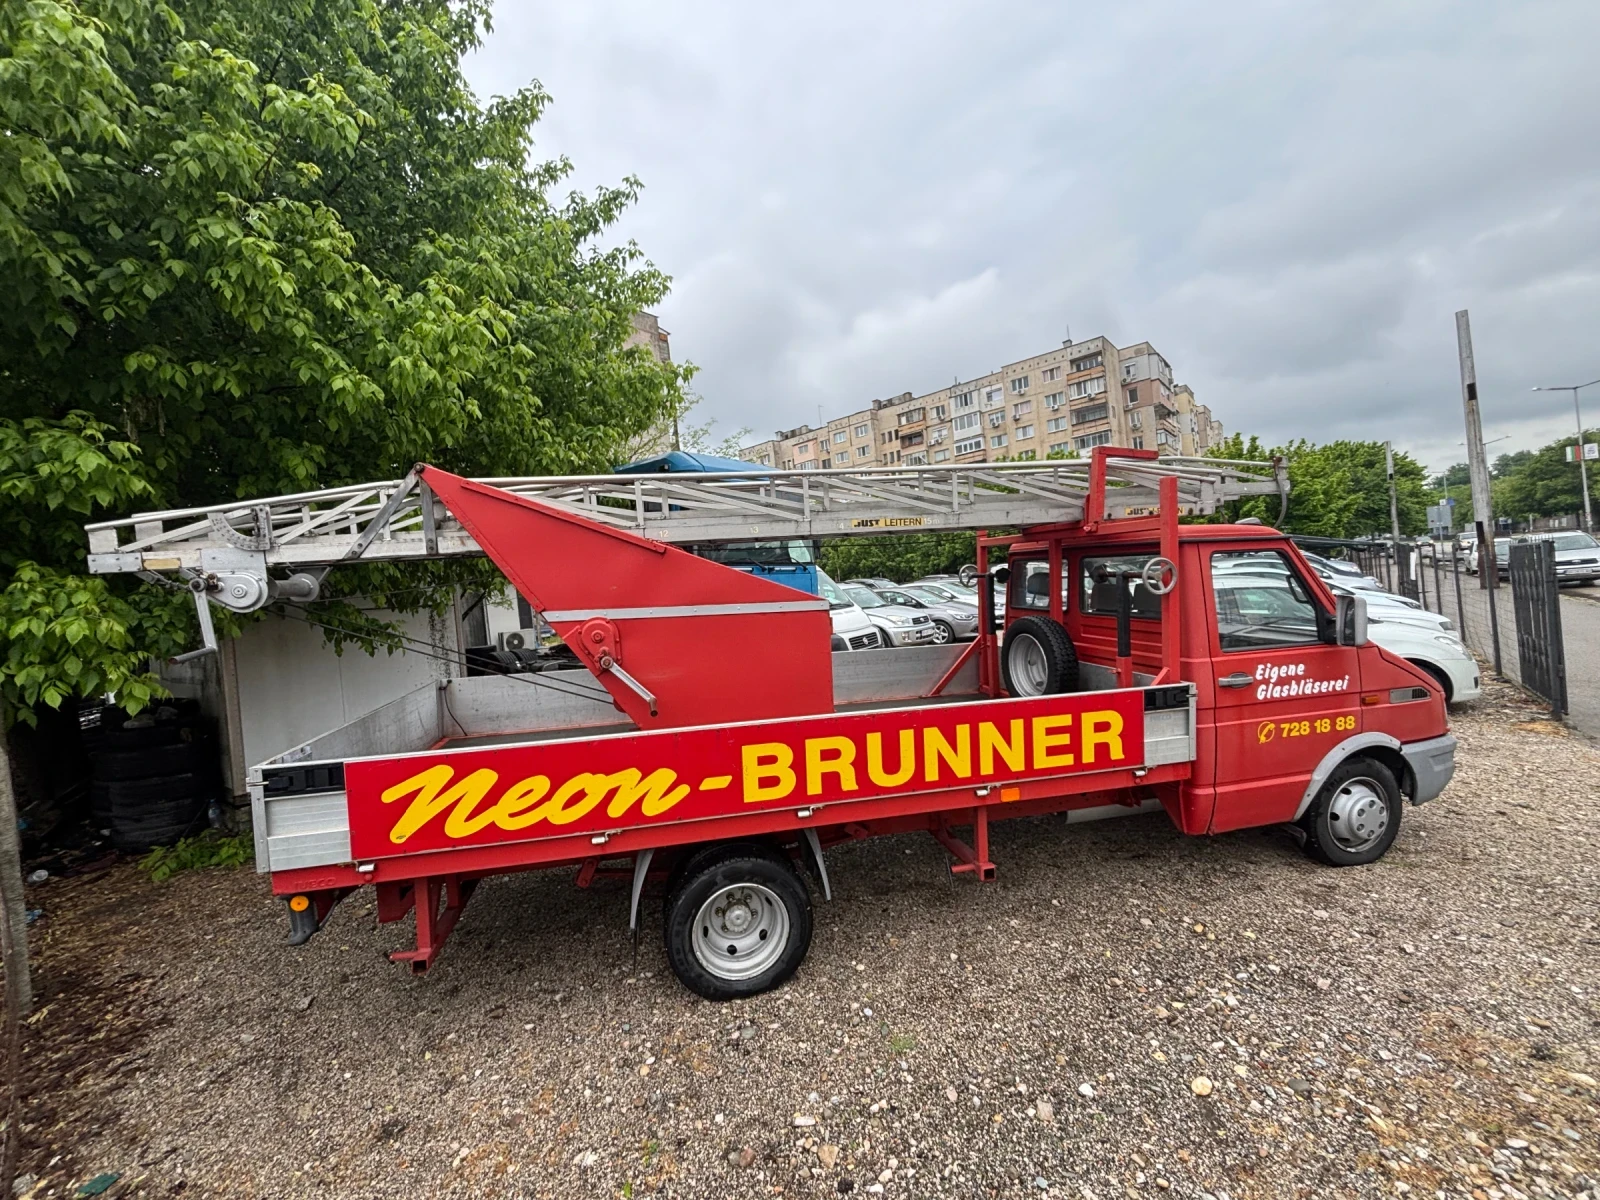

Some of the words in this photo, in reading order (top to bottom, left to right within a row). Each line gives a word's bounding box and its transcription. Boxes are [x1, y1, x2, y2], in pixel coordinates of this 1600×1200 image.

[884, 517, 921, 527] LEITERN
[659, 530, 669, 538] 12
[1255, 663, 1305, 683] Eigene
[1256, 675, 1349, 700] Glasbläserei
[1280, 721, 1310, 738] 728
[1314, 719, 1330, 734] 18
[1335, 715, 1355, 731] 88
